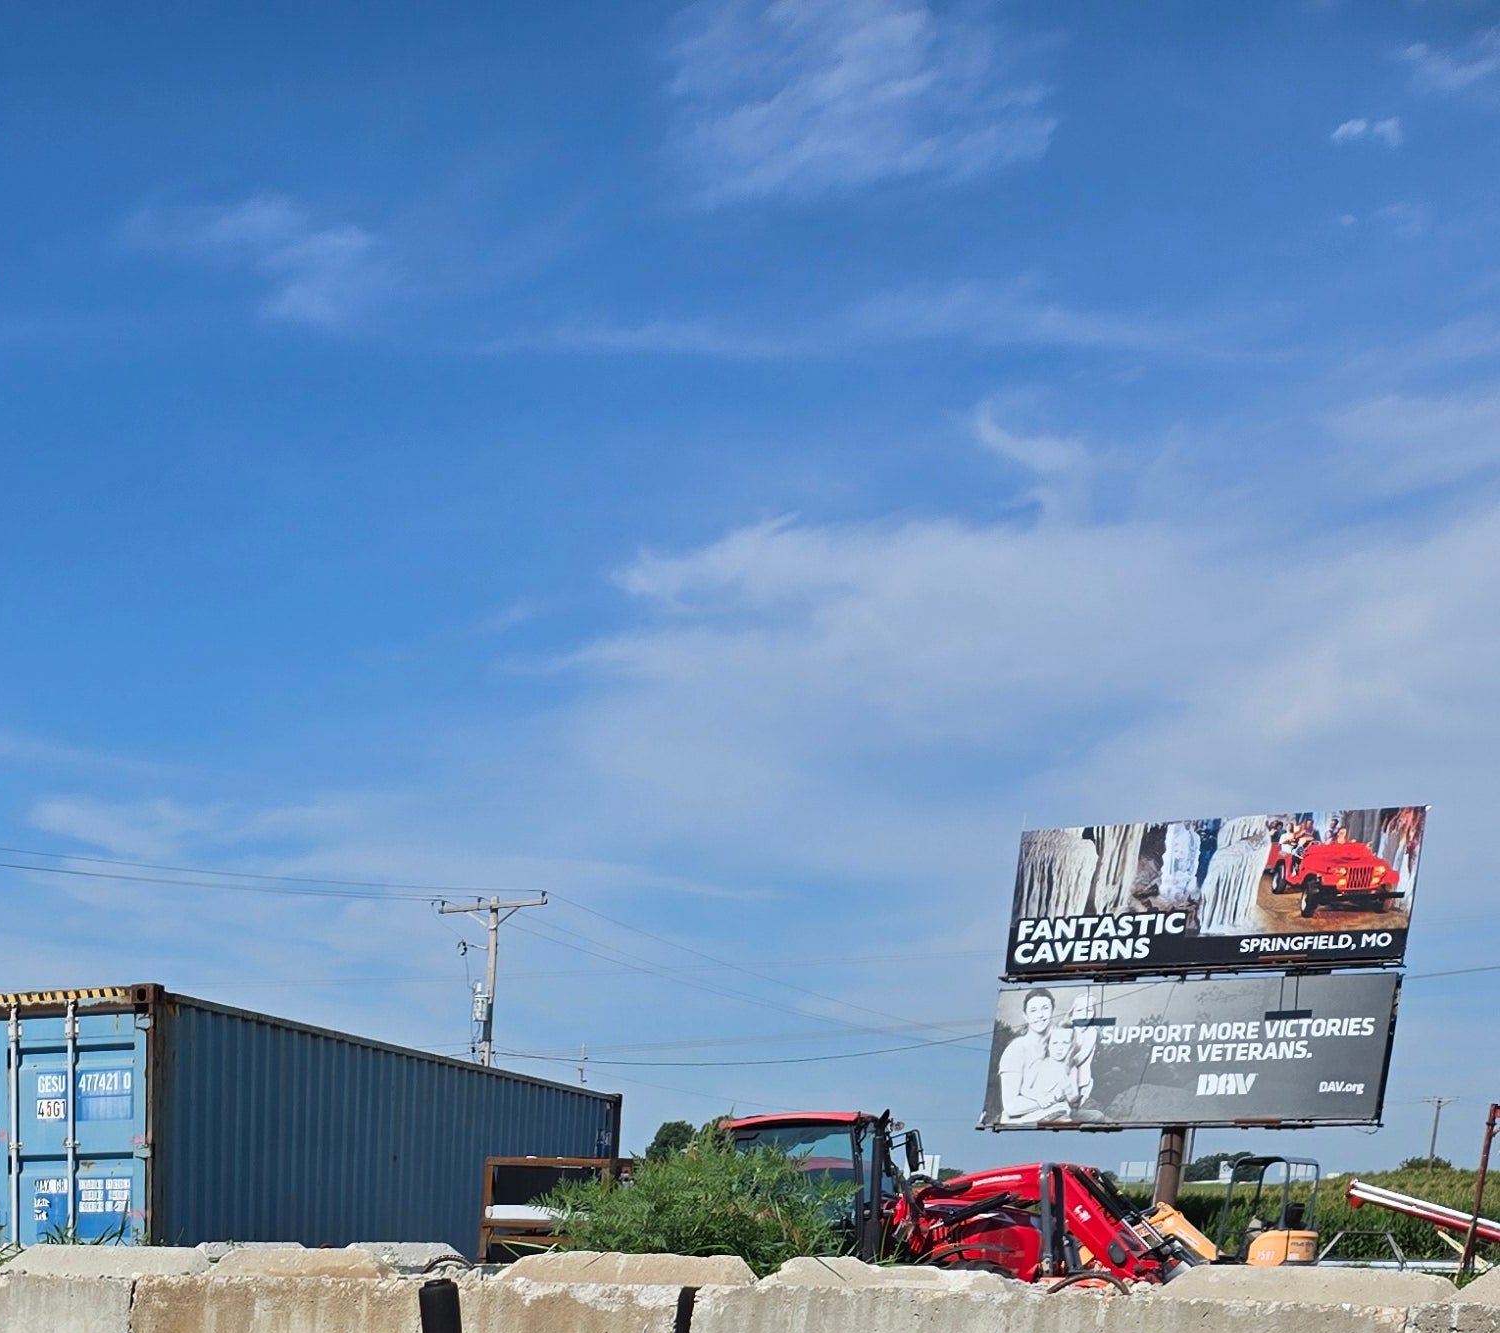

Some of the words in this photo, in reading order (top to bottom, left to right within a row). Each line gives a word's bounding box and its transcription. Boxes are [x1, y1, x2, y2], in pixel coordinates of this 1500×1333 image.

[1017, 912, 1186, 942] FANTASTIC
[1014, 937, 1151, 964] CAVERNS
[1239, 933, 1357, 953] SPRINGFIELD,
[1360, 932, 1393, 948] MO
[1100, 1023, 1195, 1045] SUPPORT
[1198, 1021, 1260, 1041] MORE
[1264, 1017, 1375, 1037] VICTORIES
[1150, 1044, 1191, 1064] FOR
[1197, 1040, 1313, 1062] VETERANS.
[37, 1075, 66, 1093] GESU
[78, 1073, 118, 1092] 477421
[1196, 1073, 1256, 1096] DAV
[1318, 1080, 1365, 1095] DAV.org
